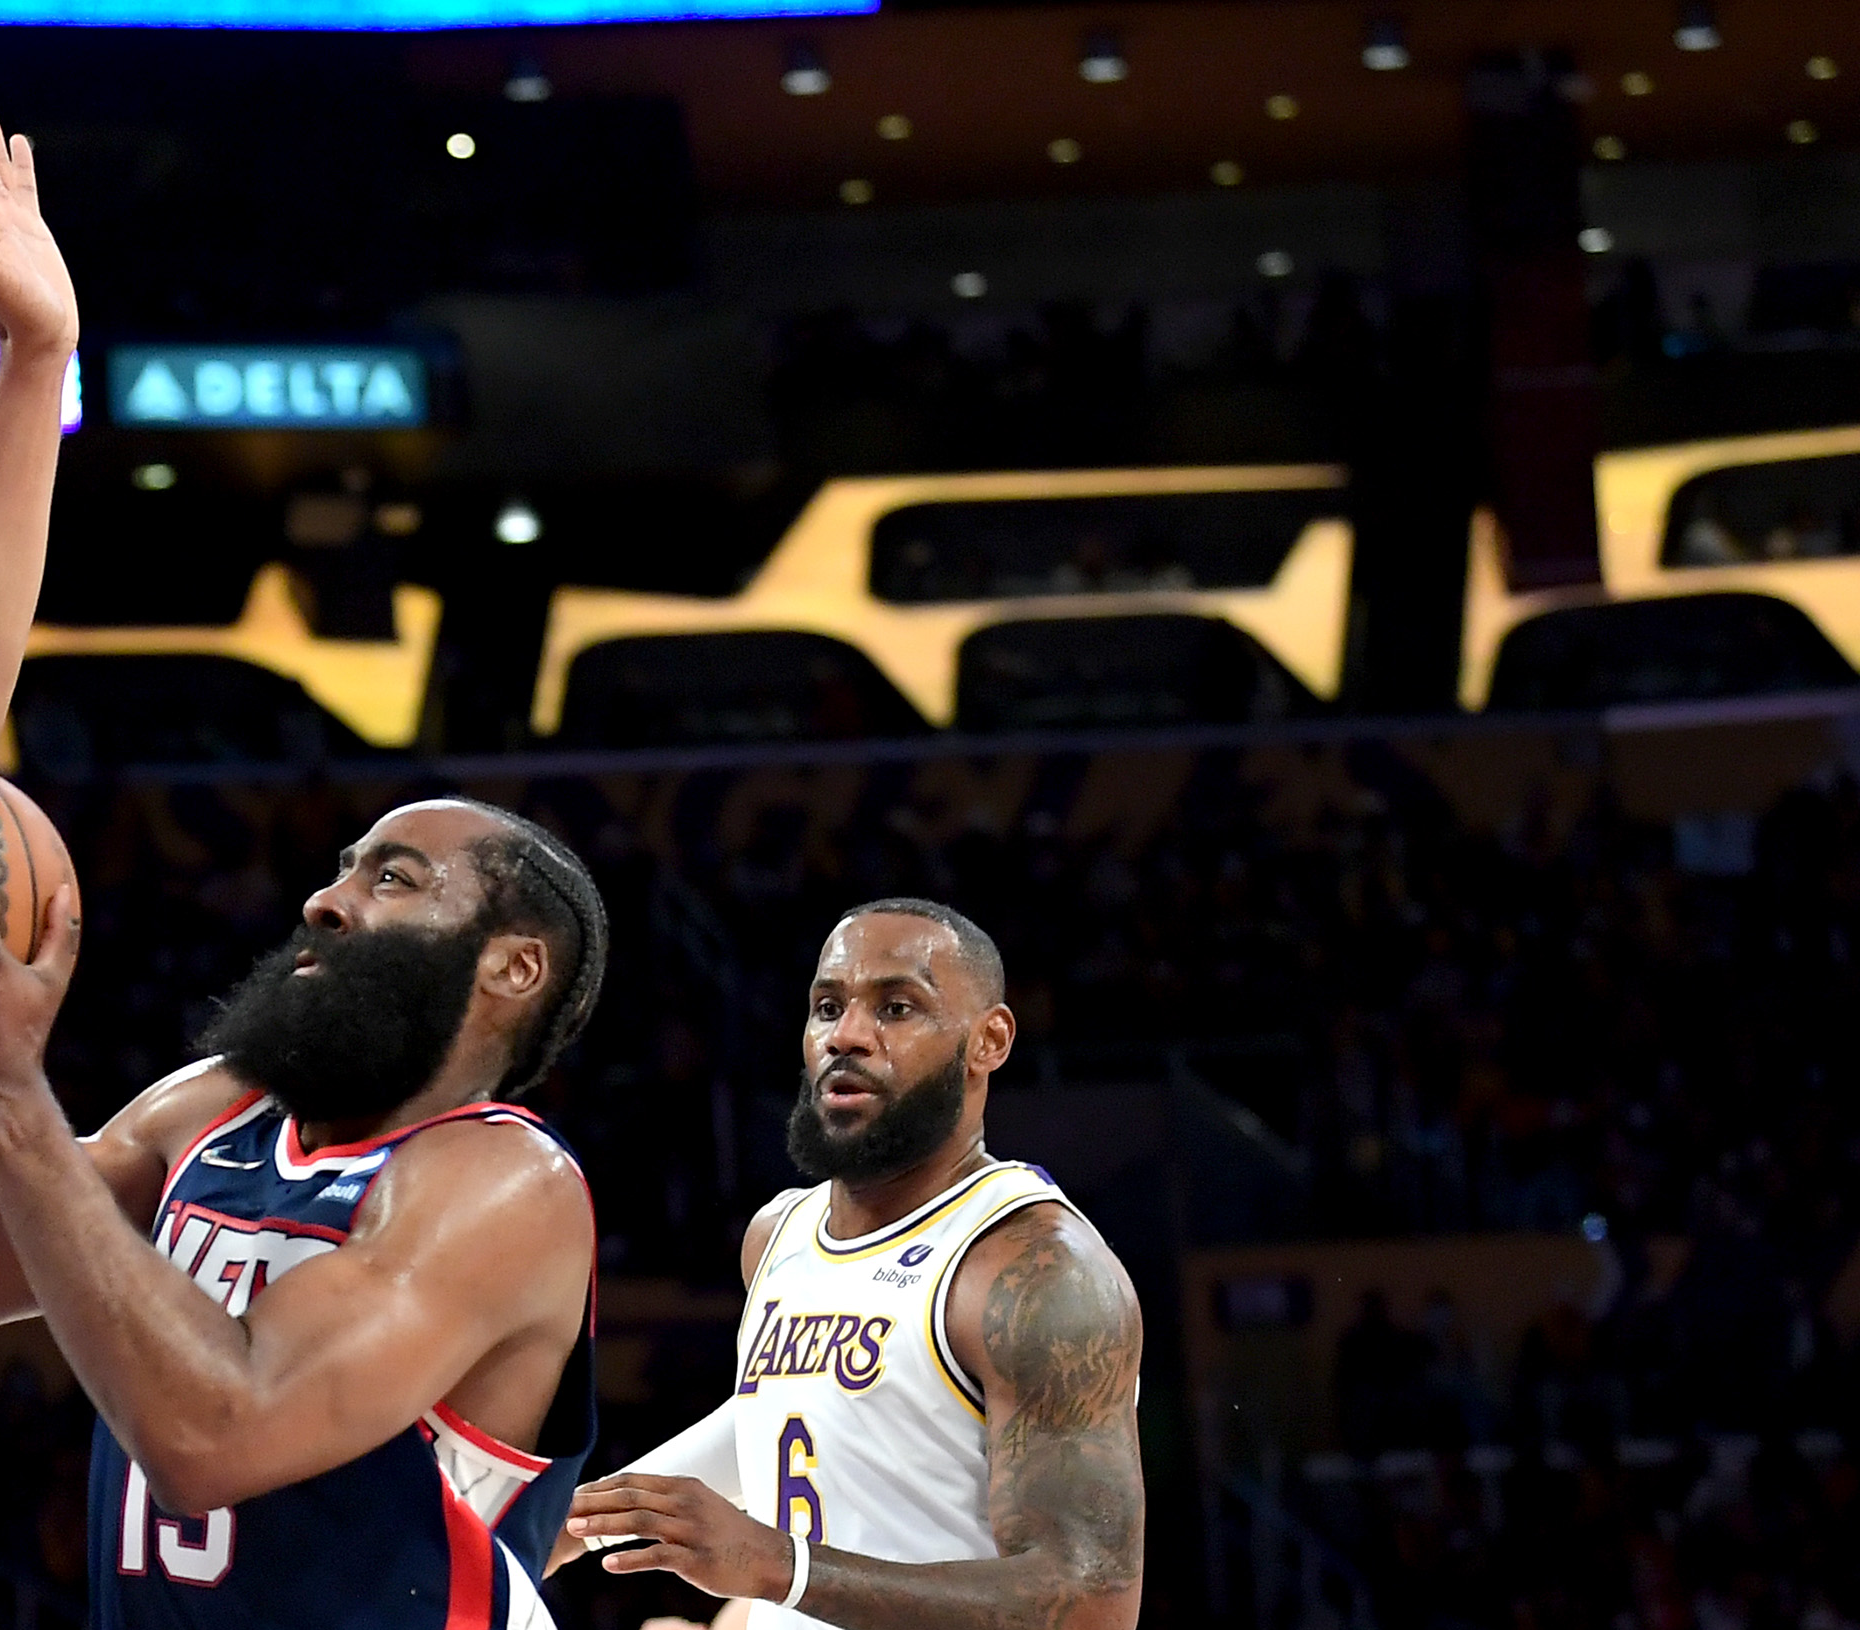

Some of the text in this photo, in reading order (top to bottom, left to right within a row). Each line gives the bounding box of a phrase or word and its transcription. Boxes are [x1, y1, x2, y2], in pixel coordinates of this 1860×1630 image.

[193, 359, 411, 418] DELTA
[155, 1199, 350, 1318] NET
[872, 1267, 922, 1289] bibigo
[737, 1298, 897, 1397] LAKERS
[776, 1412, 828, 1545] 6
